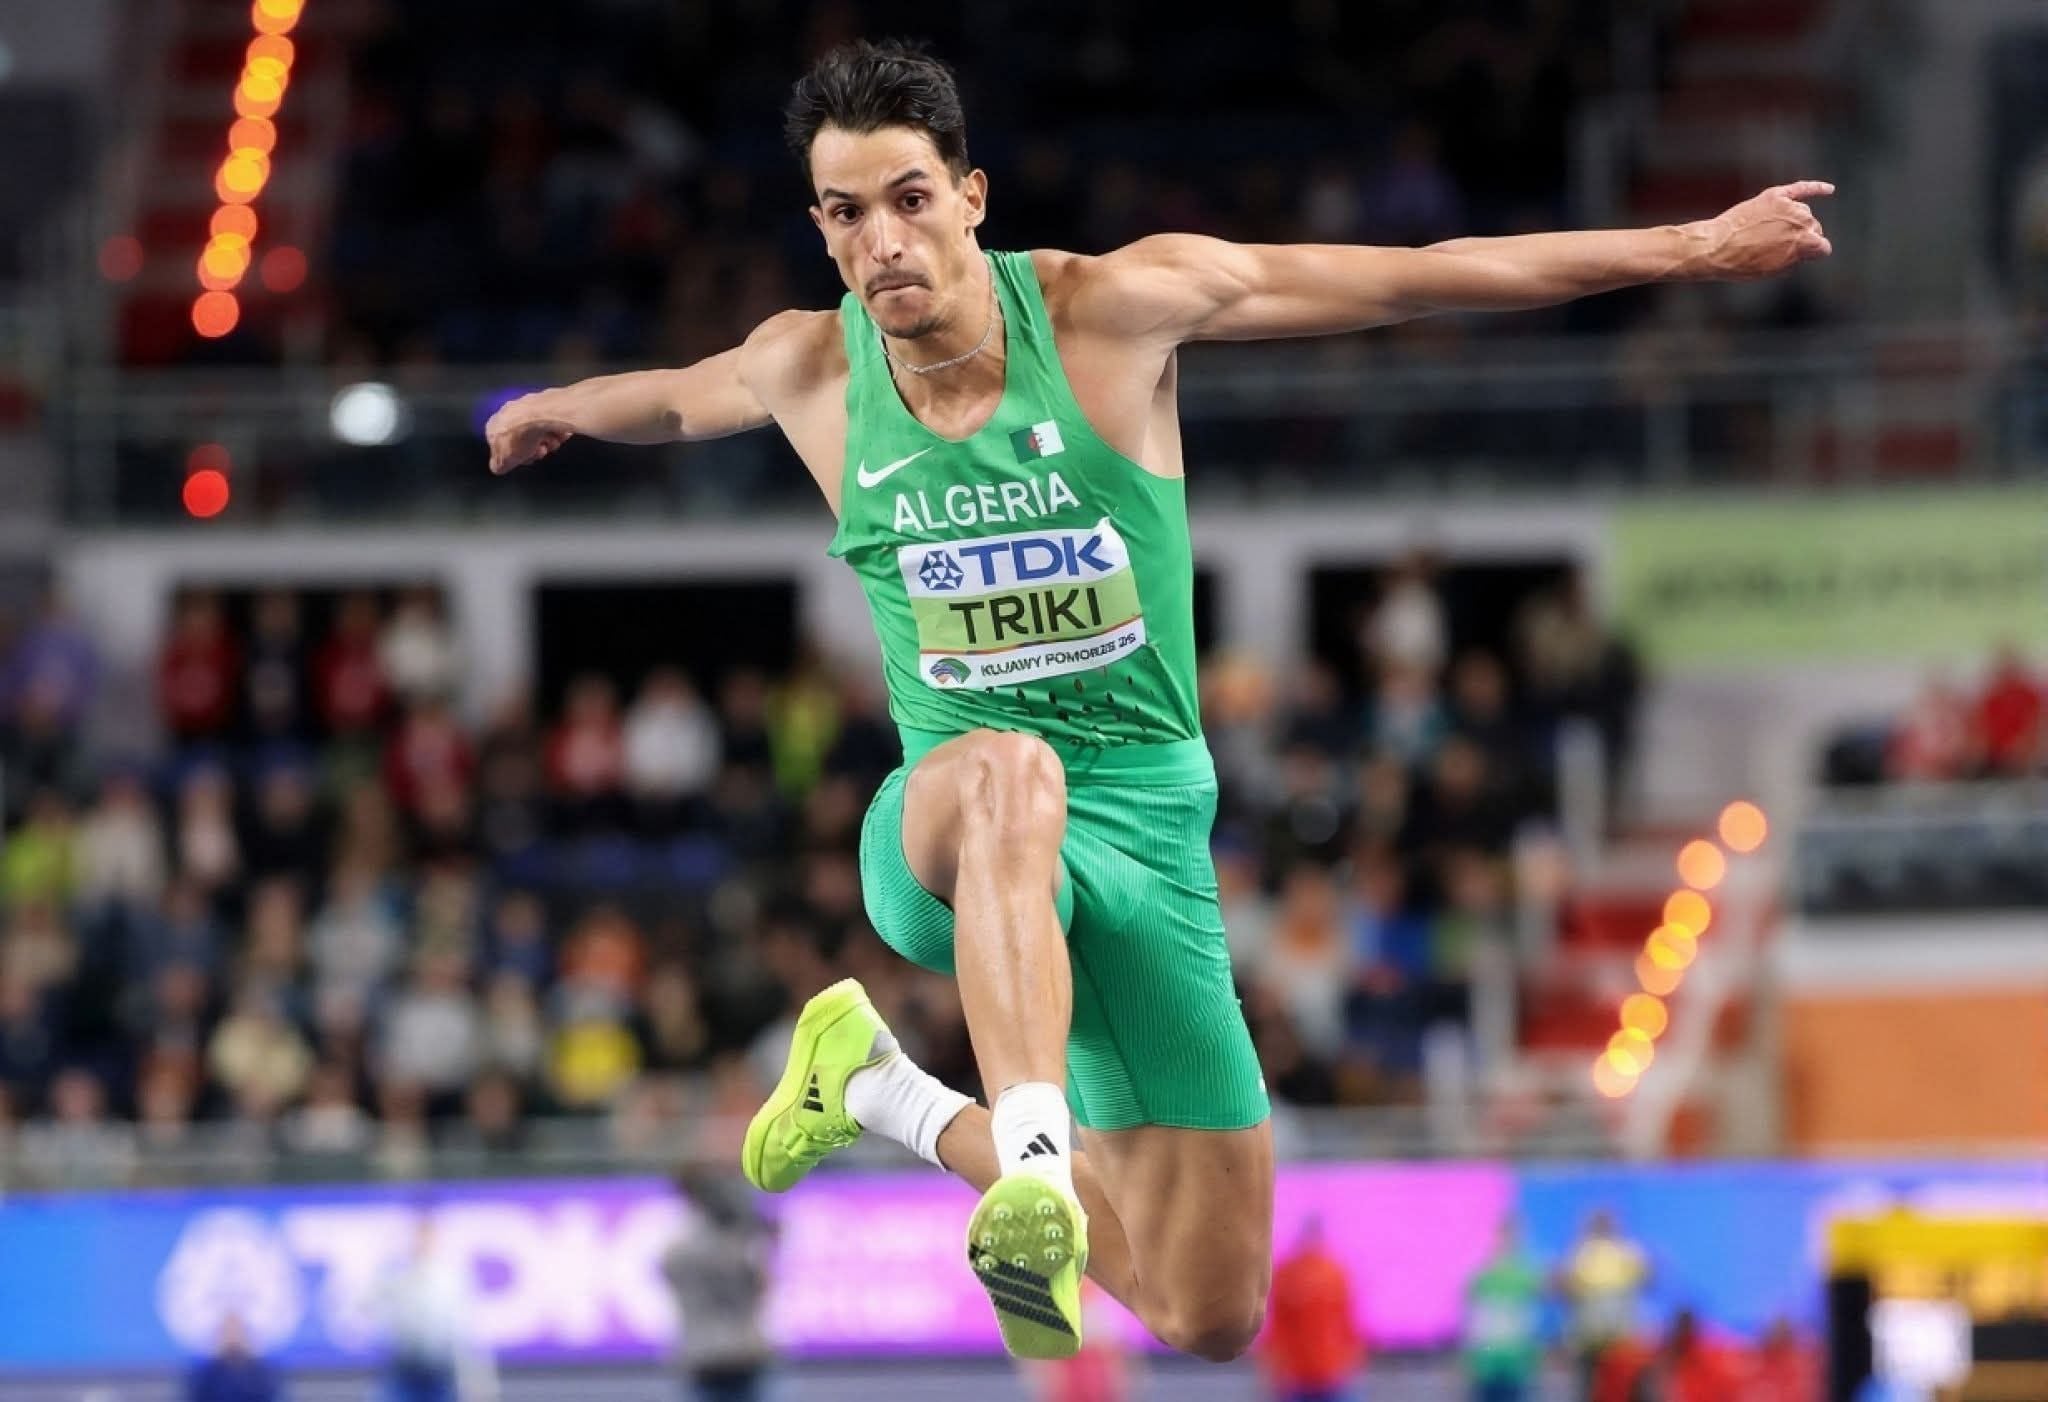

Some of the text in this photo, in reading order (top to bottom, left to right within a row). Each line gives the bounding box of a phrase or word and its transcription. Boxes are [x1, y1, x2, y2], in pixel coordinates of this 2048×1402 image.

[893, 471, 1080, 532] ALGERIA
[958, 535, 1114, 586] TDK
[949, 587, 1101, 644] TRIKI
